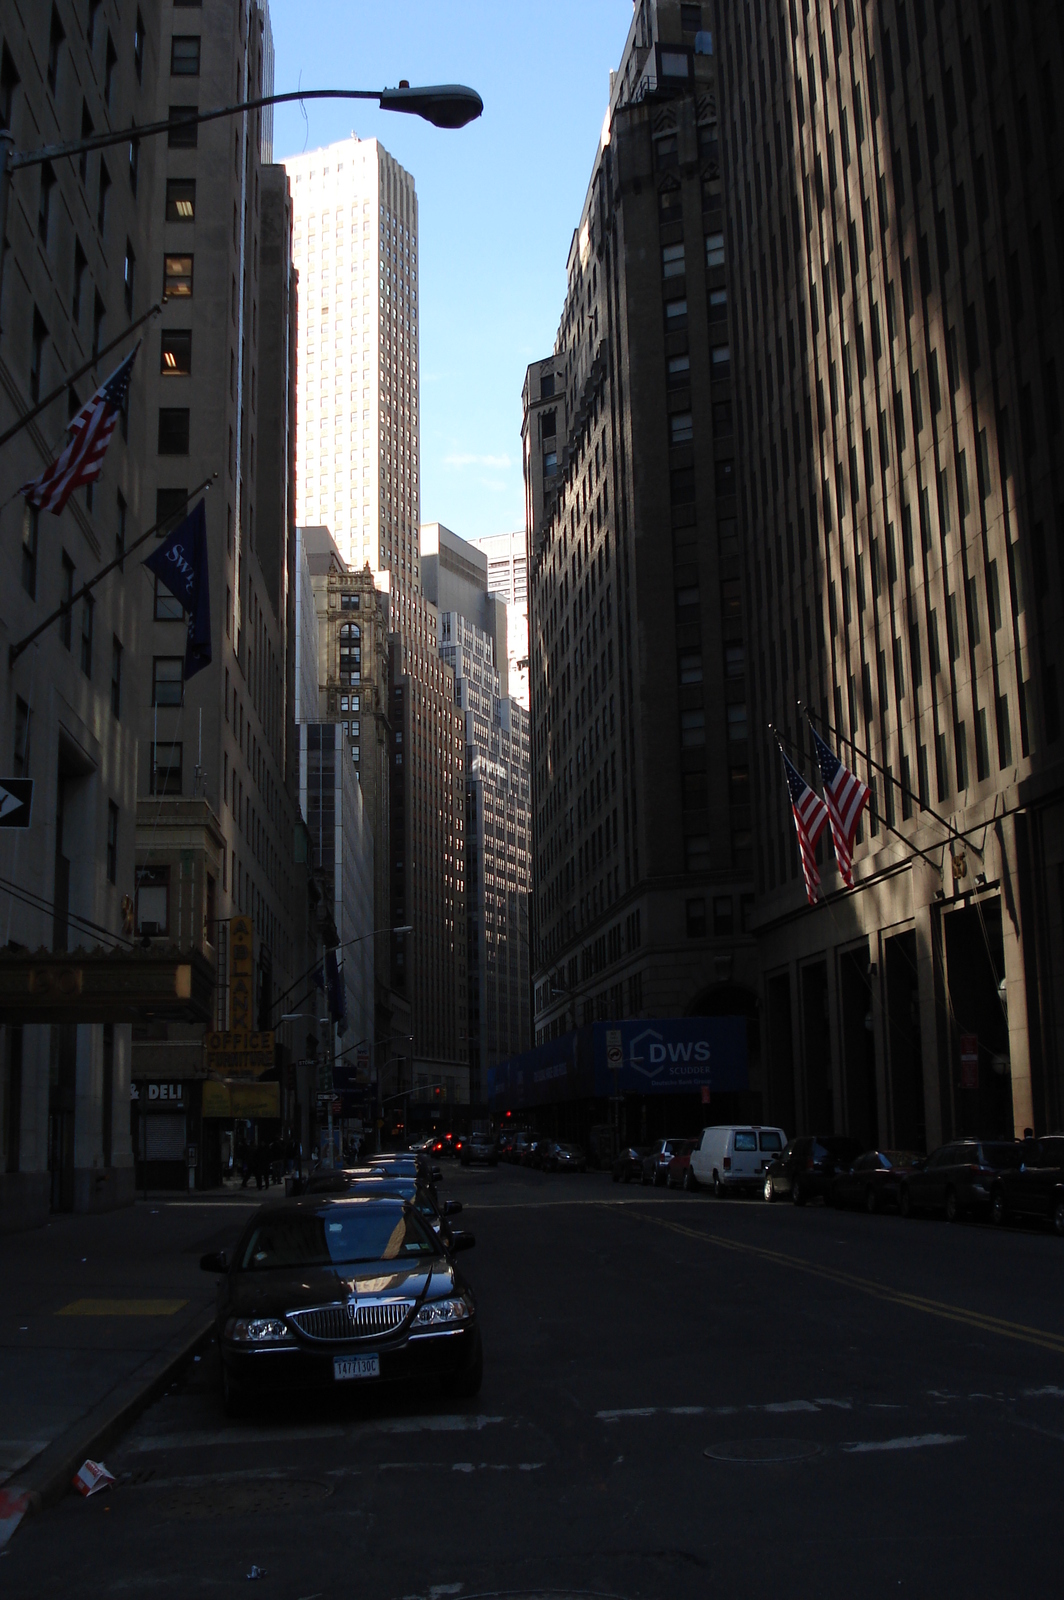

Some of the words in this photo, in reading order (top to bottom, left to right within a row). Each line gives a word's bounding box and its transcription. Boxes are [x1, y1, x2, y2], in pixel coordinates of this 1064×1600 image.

[210, 1033, 270, 1049] OFFICE
[208, 1051, 273, 1067] FURNITURE
[649, 1041, 711, 1063] DWS
[669, 1066, 710, 1075] SCUDDER
[148, 1084, 182, 1100] DELI
[337, 1360, 376, 1375] T477130C
